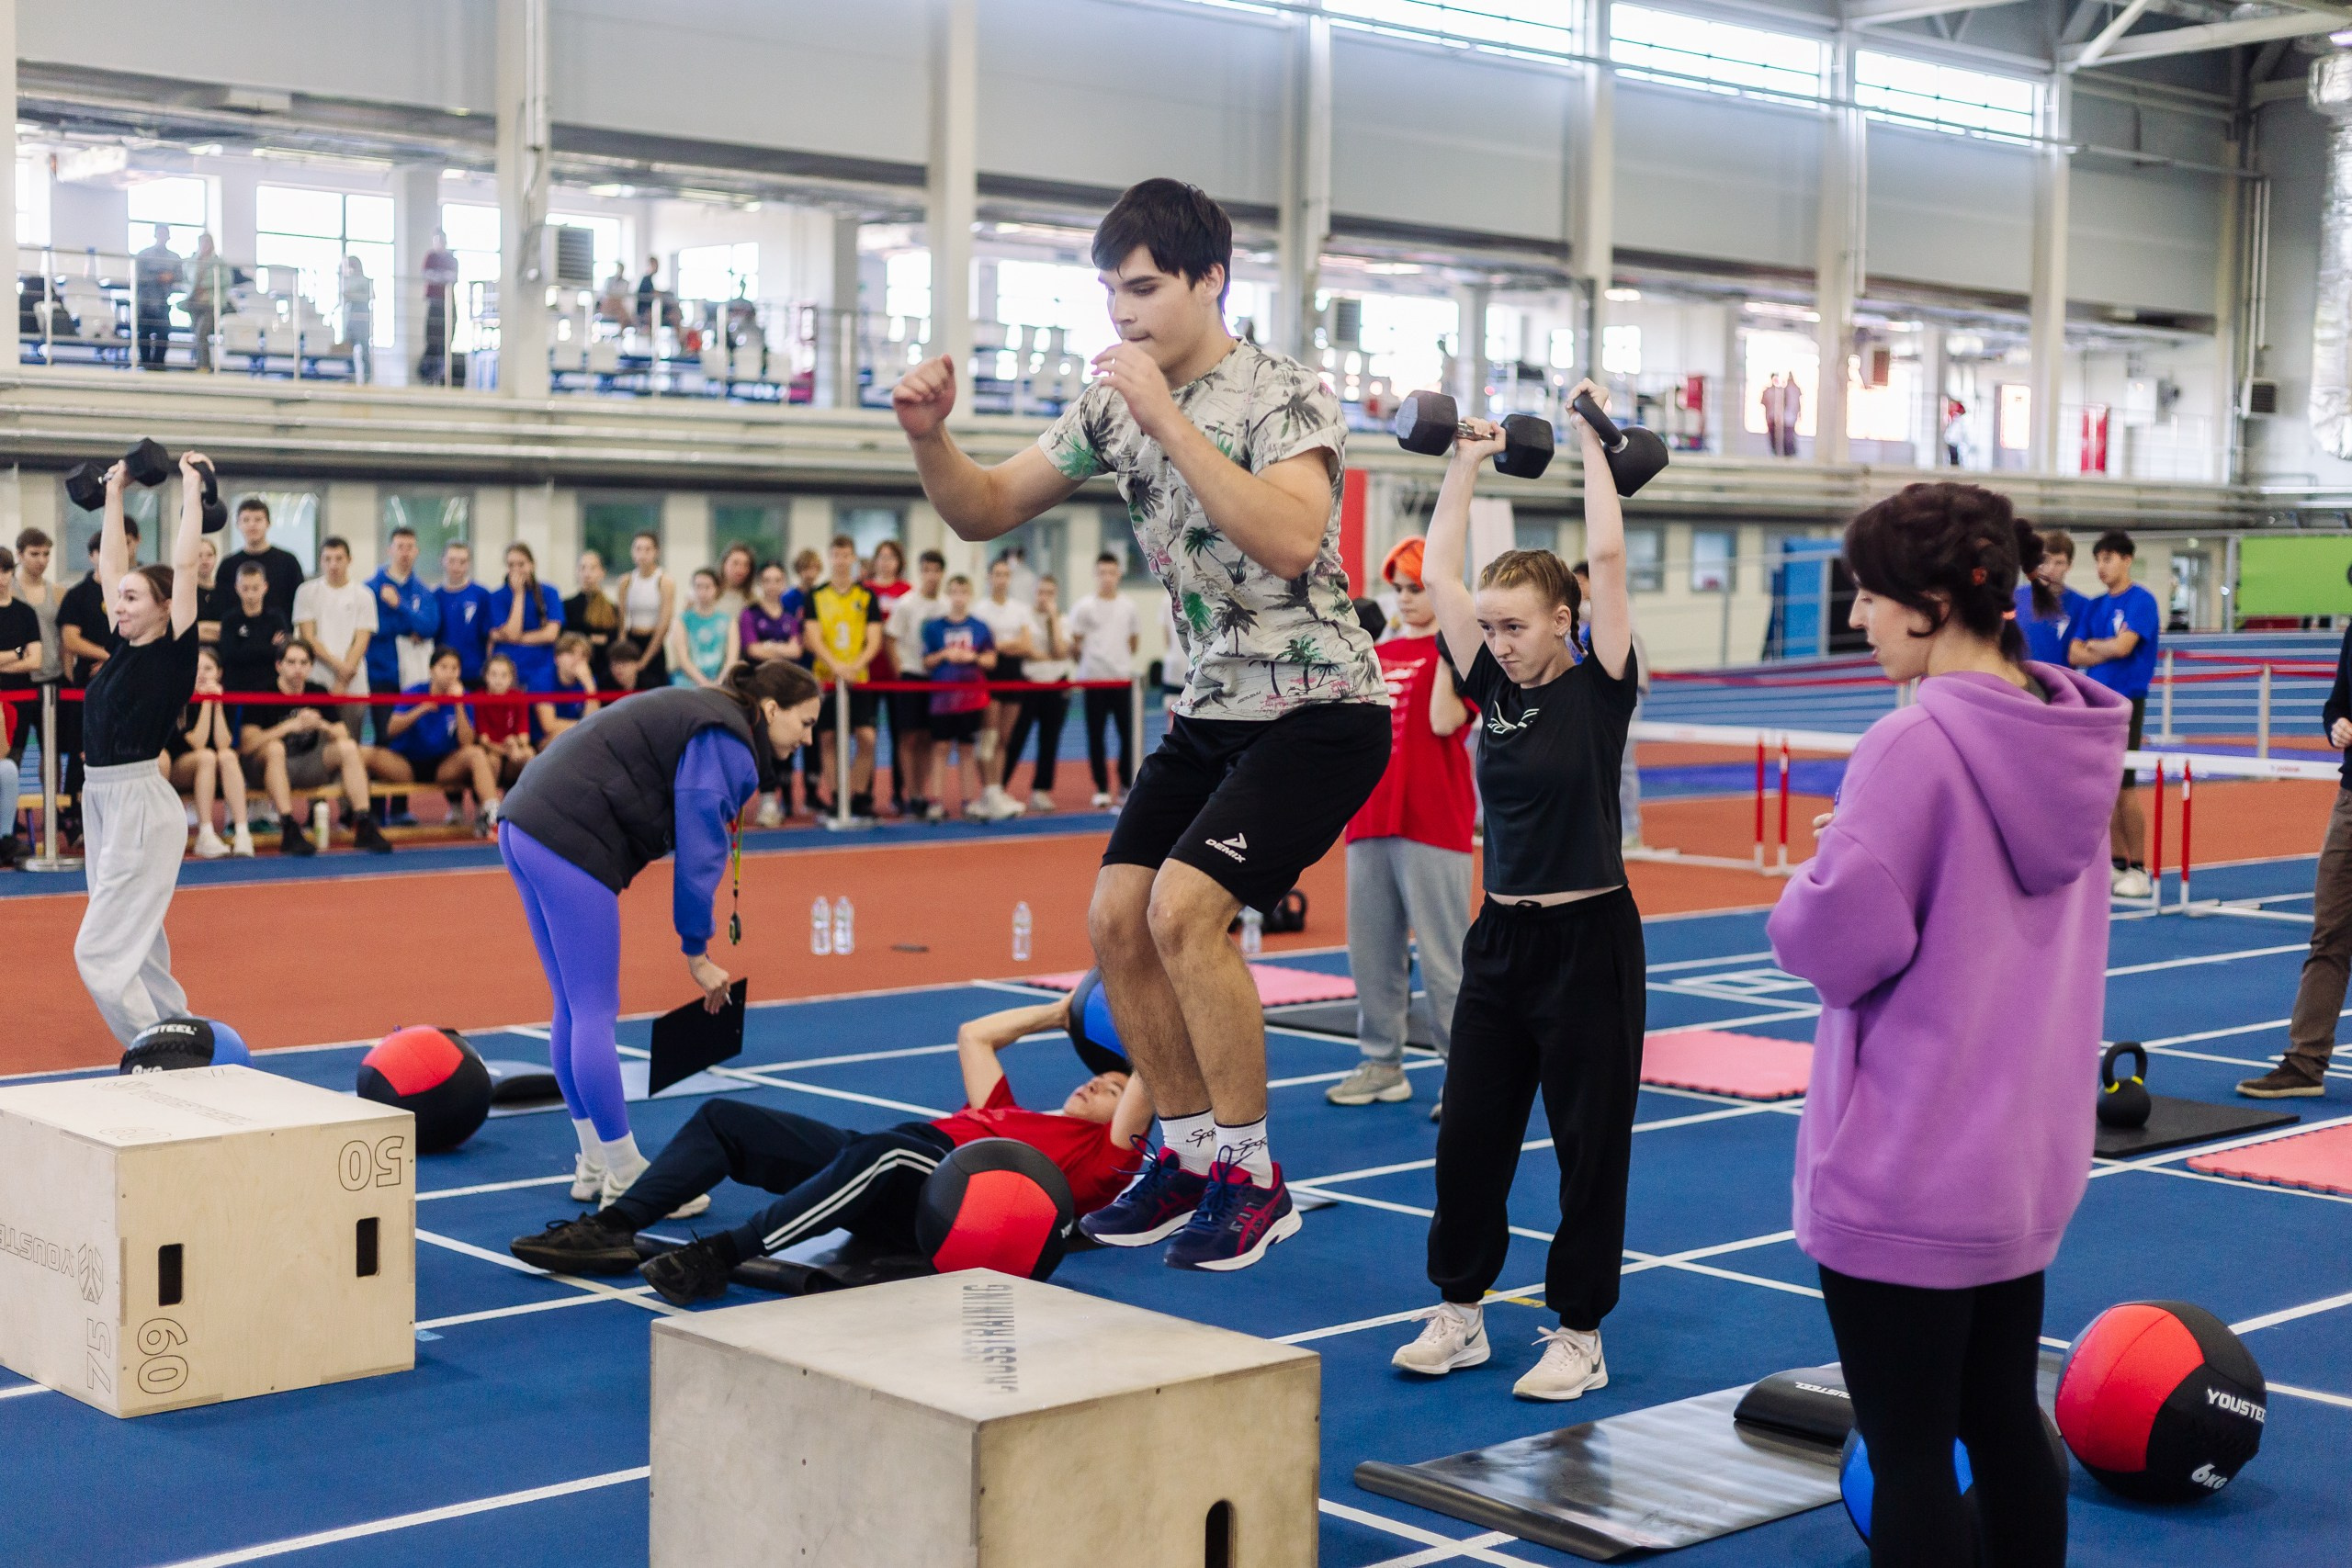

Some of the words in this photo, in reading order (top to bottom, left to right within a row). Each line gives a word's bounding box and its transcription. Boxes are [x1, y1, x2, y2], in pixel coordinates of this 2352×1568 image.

[1205, 839, 1246, 863] DEMIX
[338, 1135, 404, 1191] 50
[86, 1317, 111, 1394] 75
[137, 1317, 189, 1394] 60
[2191, 1462, 2229, 1490] 6KG
